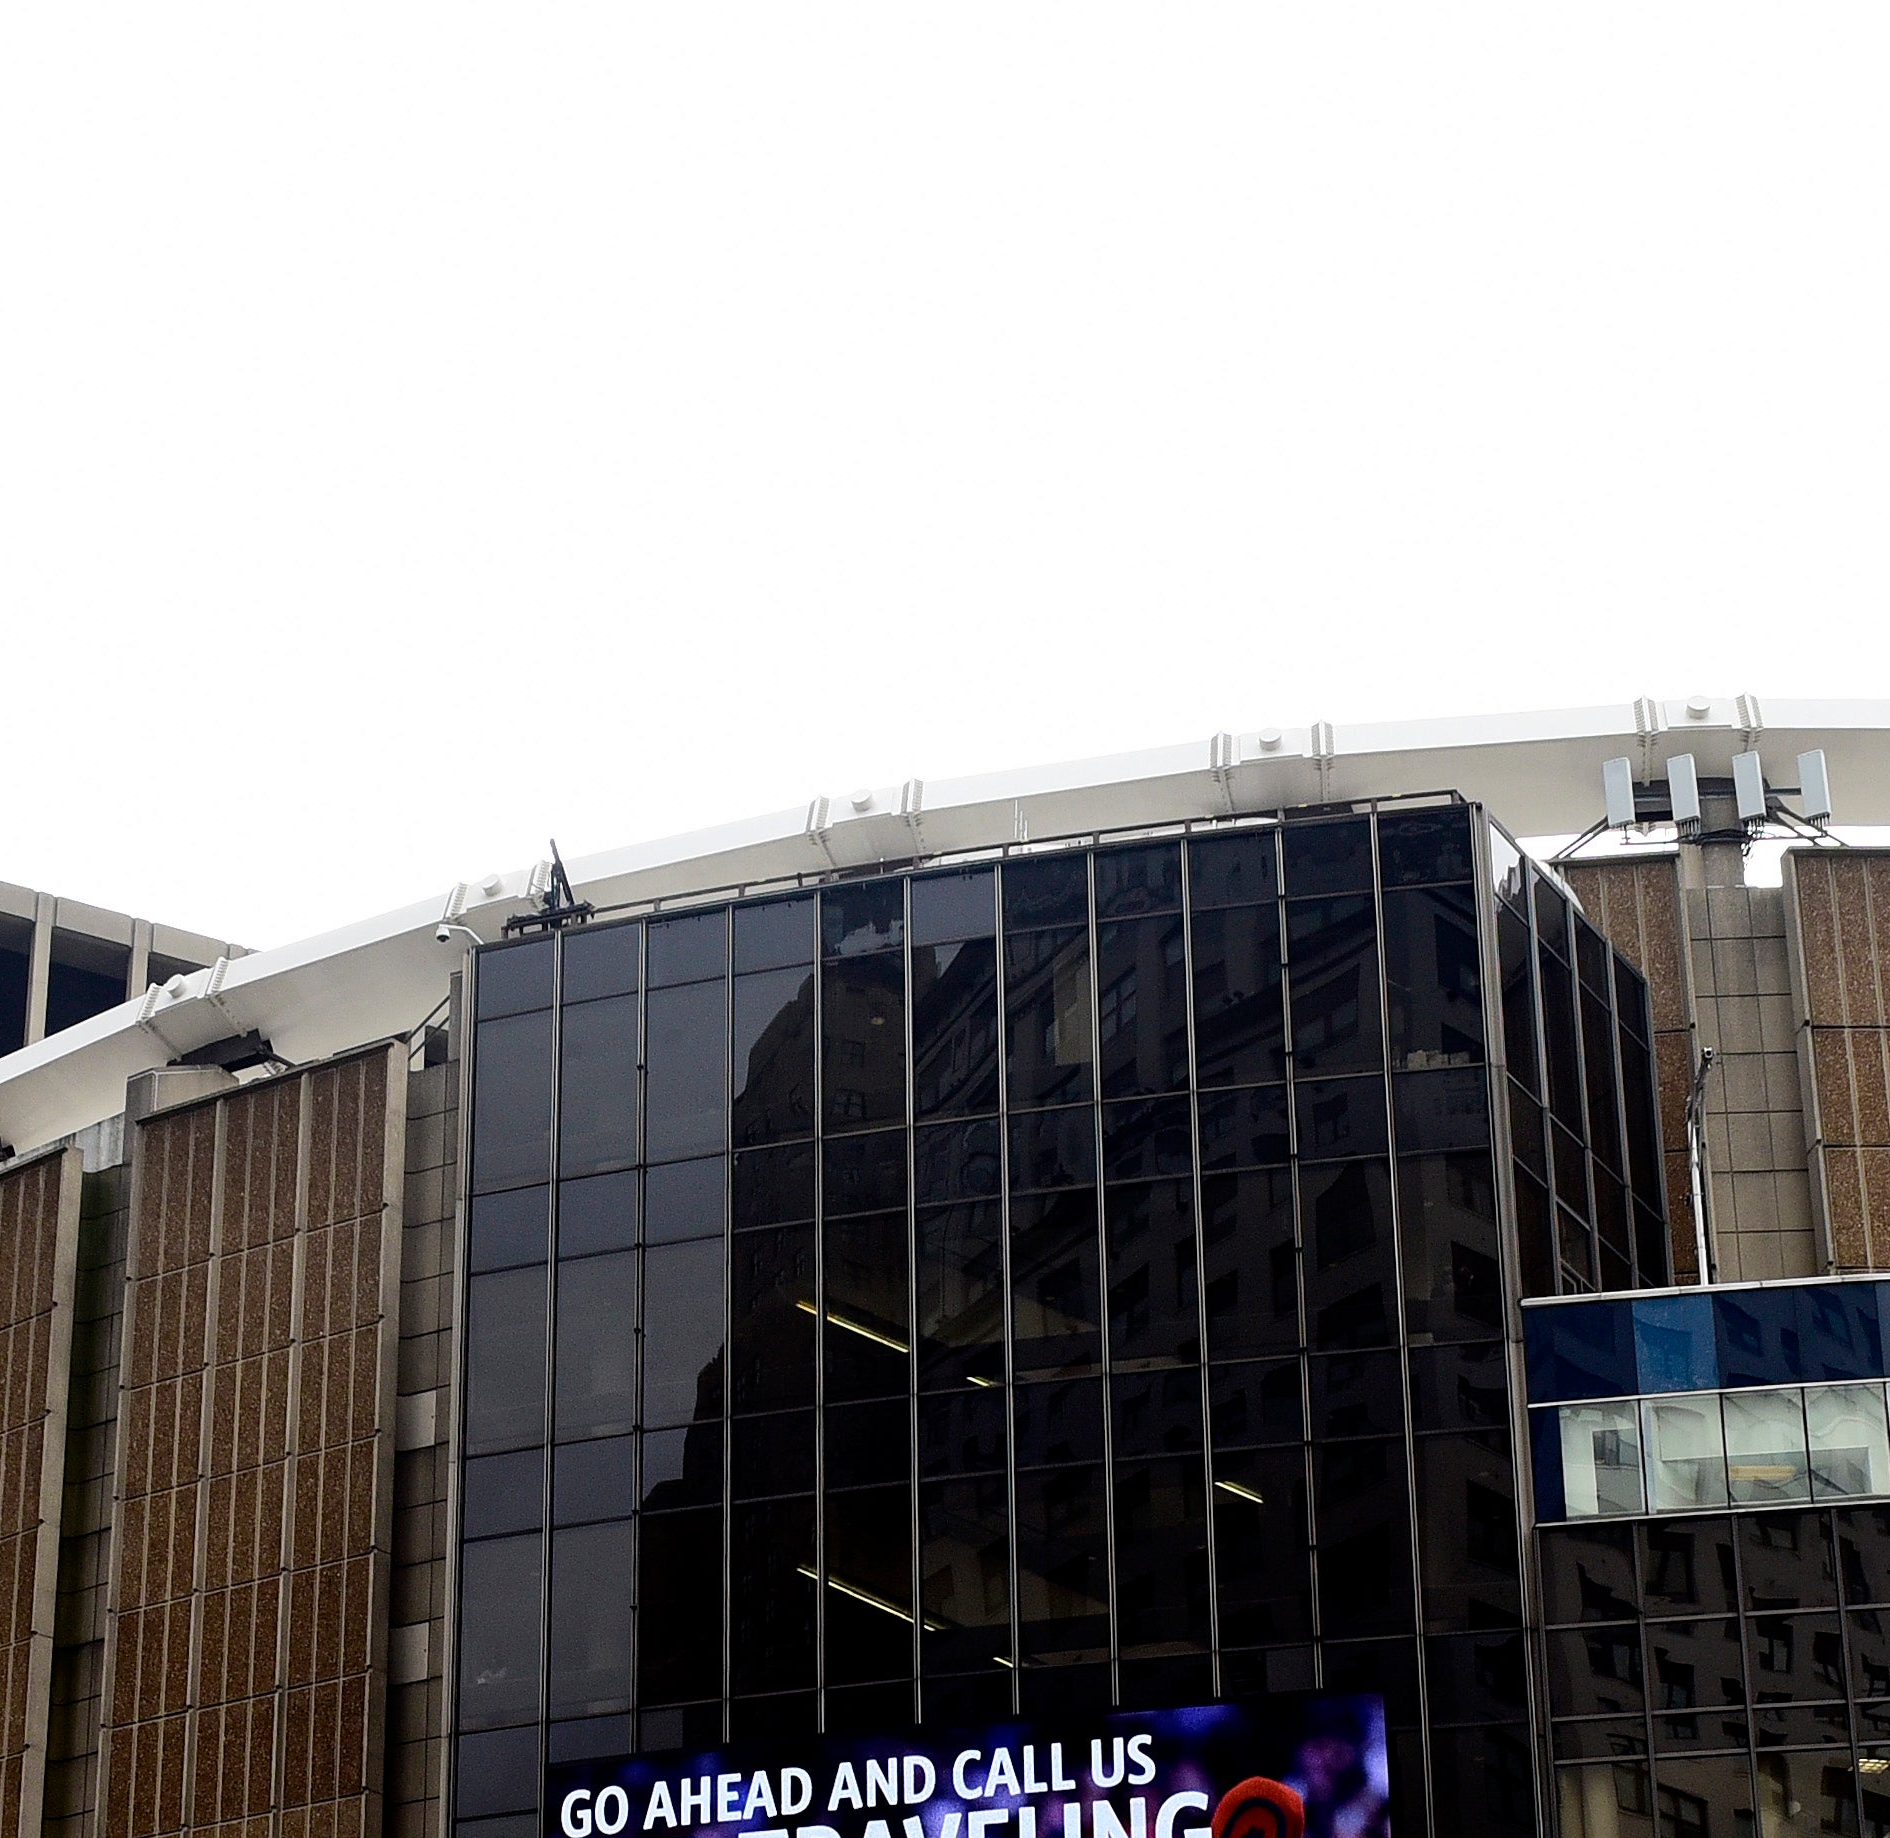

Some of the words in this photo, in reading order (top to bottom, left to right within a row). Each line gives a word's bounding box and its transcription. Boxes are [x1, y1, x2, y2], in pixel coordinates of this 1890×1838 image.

[560, 1789, 629, 1838] GO
[643, 1766, 812, 1831] AHEAD
[828, 1754, 936, 1811] AND
[952, 1742, 1077, 1801] CALL
[1090, 1733, 1157, 1788] US
